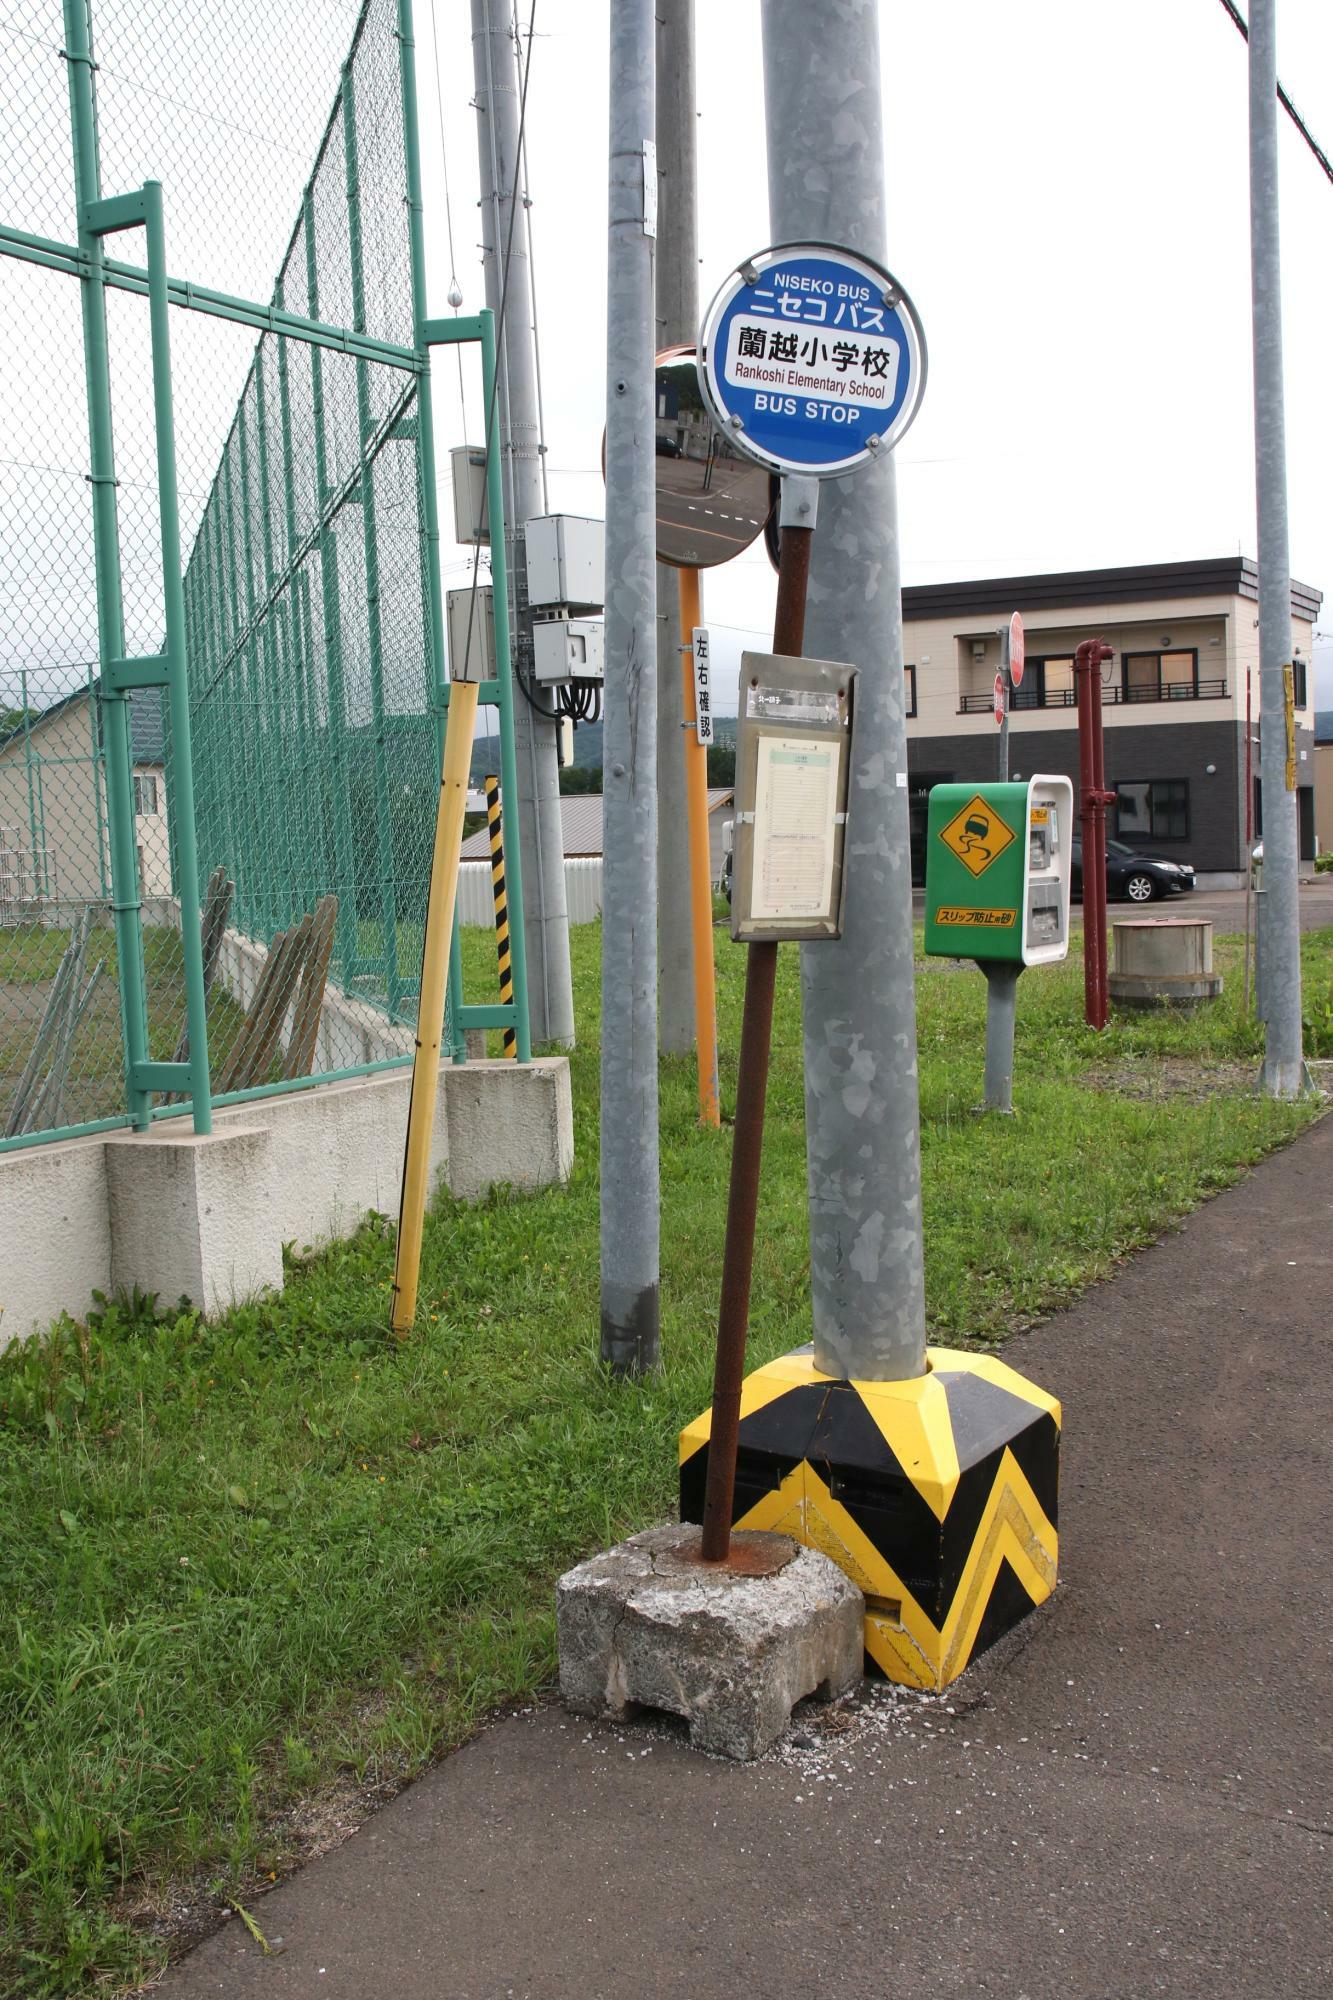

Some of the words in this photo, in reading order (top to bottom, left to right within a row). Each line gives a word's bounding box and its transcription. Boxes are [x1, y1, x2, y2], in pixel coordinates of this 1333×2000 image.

[774, 272, 834, 295] NISEKO
[837, 283, 870, 301] BUS
[737, 326, 891, 380] 蘭越小学校
[735, 362, 786, 384] Rankoshi
[787, 370, 846, 396] Elementary
[848, 380, 886, 400] School
[754, 393, 797, 416] BUS
[805, 401, 860, 425] STOP
[696, 635, 711, 737] 左右確認
[940, 911, 1012, 924] スリップ防止用砂
